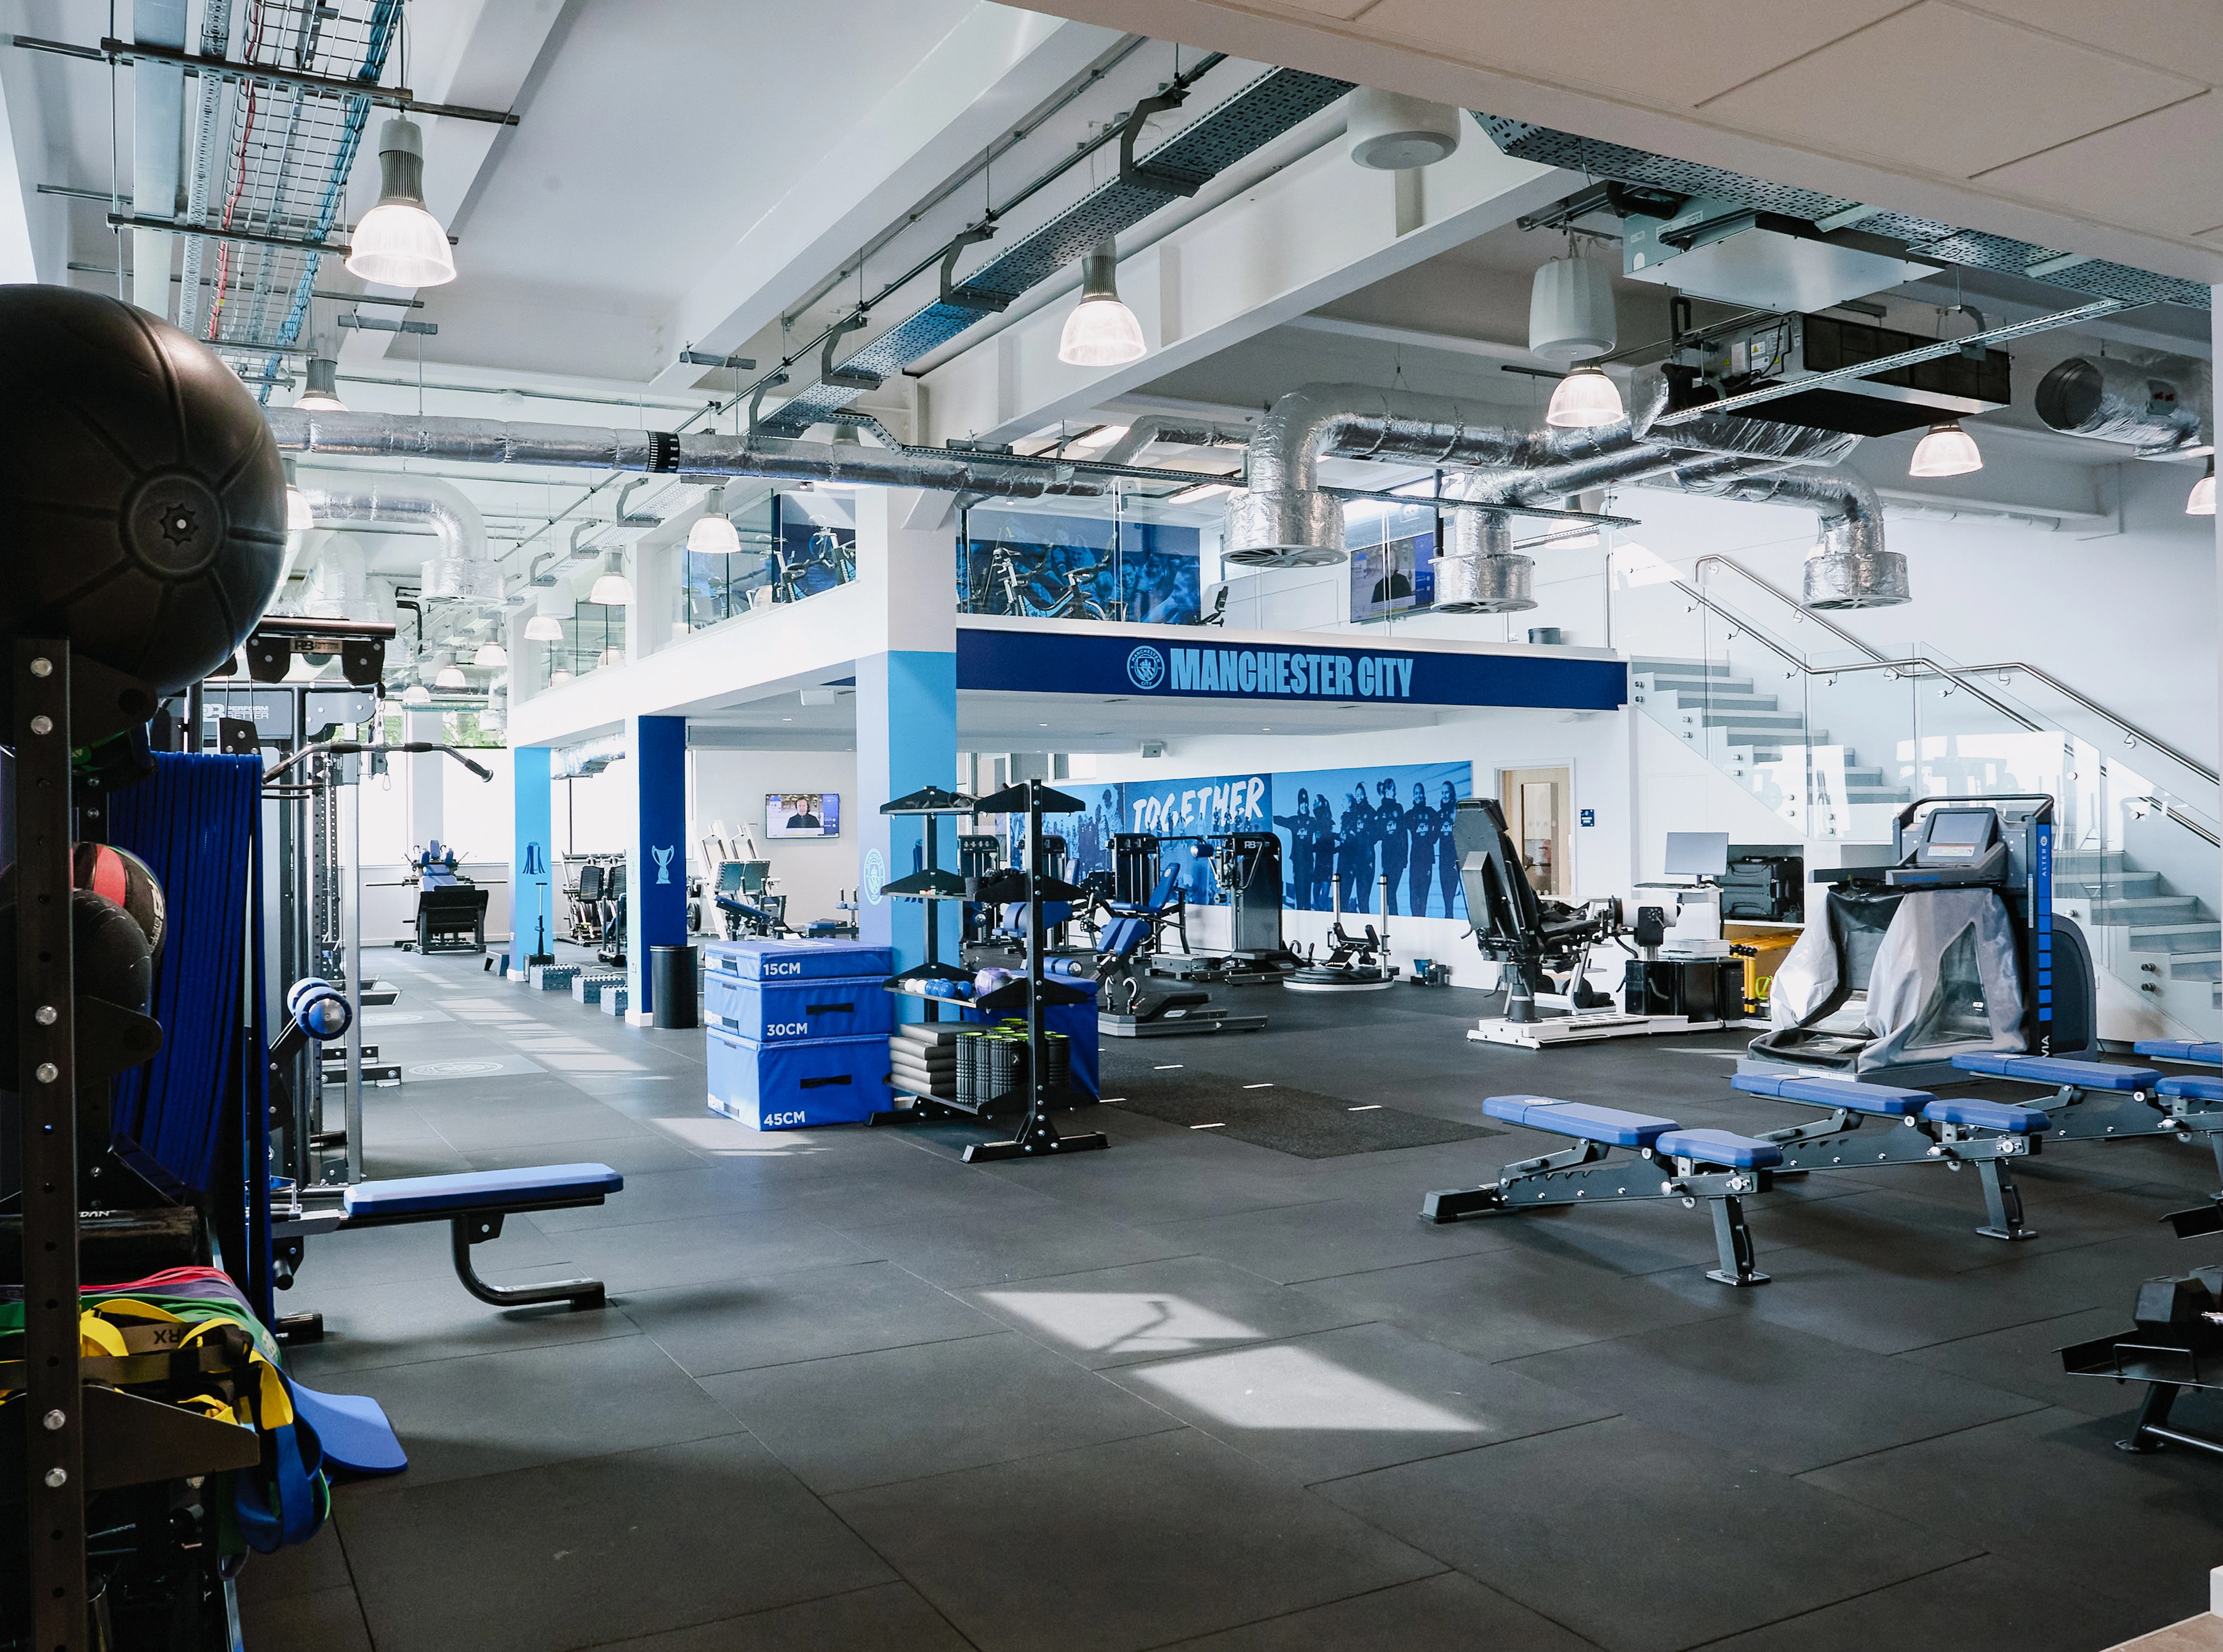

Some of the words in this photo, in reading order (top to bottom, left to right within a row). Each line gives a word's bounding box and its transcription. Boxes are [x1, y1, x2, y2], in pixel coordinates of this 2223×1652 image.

[1171, 648, 1353, 695] MANCHESTER
[1358, 656, 1413, 697] CITY
[1133, 776, 1265, 833] TOGETHER
[763, 963, 801, 975] 15CM
[766, 1023, 808, 1036] 30CM
[763, 1111, 805, 1126] 45CM
